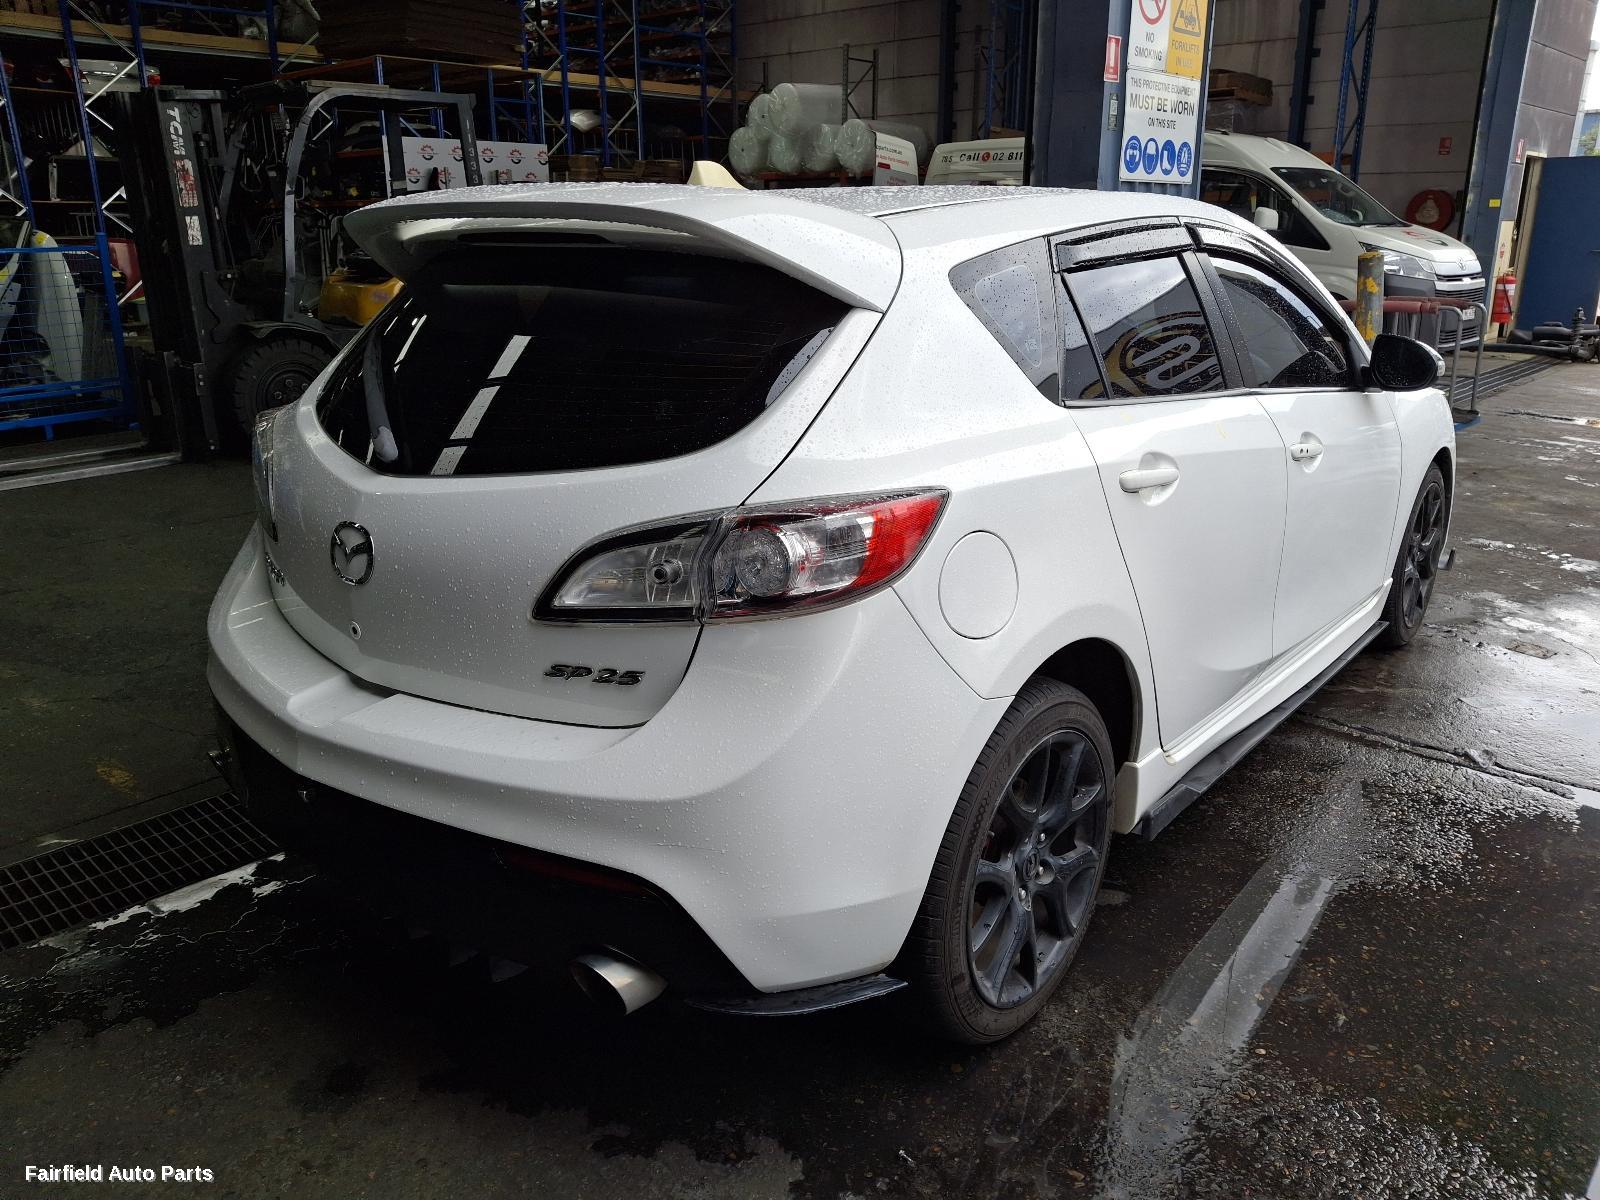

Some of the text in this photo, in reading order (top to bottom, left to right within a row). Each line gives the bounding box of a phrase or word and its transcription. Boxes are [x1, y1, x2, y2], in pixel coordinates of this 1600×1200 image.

[1145, 31, 1155, 43] NO
[1134, 46, 1163, 61] SMOKING
[1171, 40, 1200, 55] FORKLIFTS
[1131, 77, 1196, 97] THIS PROTECTIVE EQUIPMENT
[1129, 92, 1195, 117] MUST BE WORN
[166, 106, 186, 156] TCM
[1147, 117, 1177, 130] ON THIS SITE
[959, 152, 981, 162] Call
[992, 152, 1004, 161] 02
